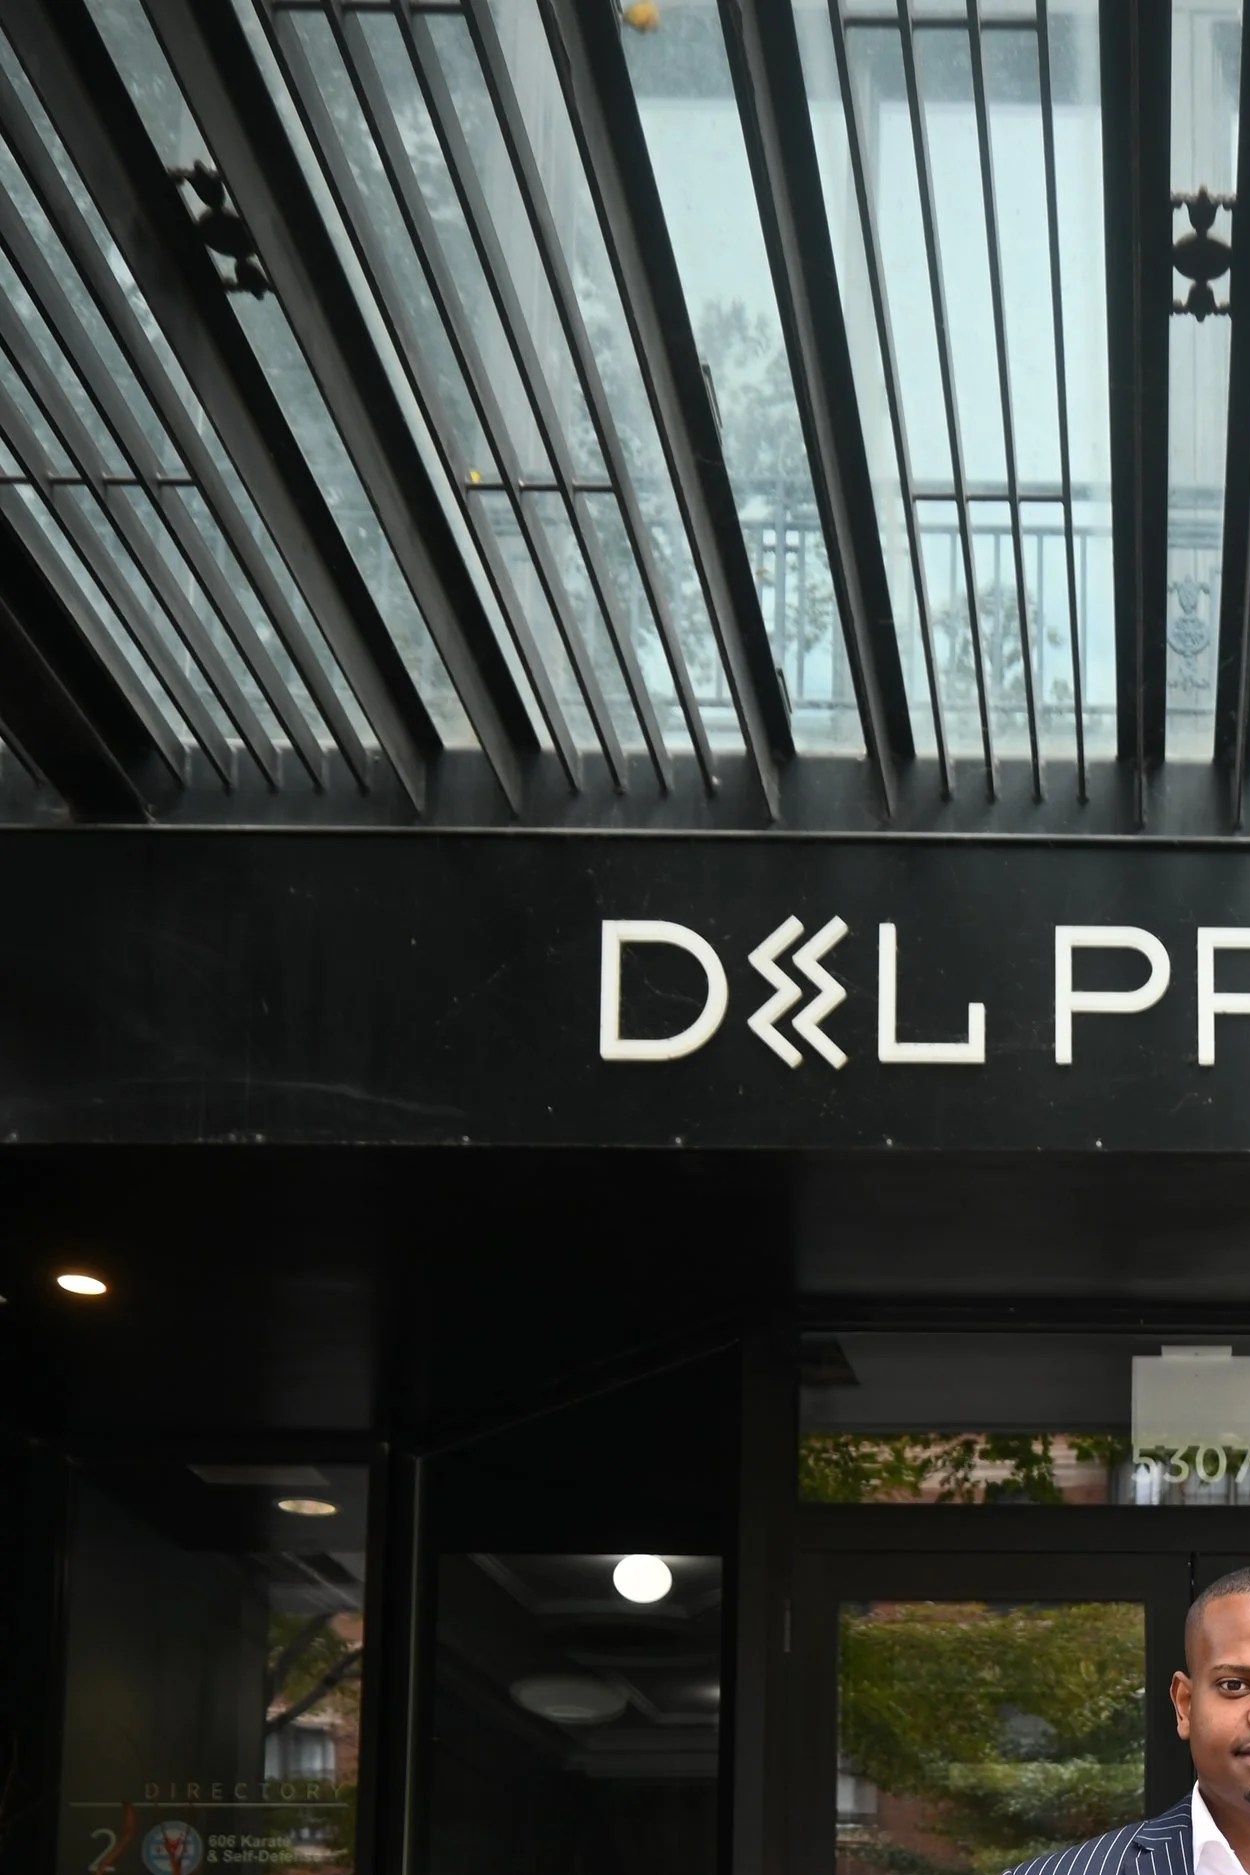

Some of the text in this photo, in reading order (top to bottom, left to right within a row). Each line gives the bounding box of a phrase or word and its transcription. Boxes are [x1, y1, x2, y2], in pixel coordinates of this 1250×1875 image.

[600, 914, 986, 1070] DEL
[144, 1782, 343, 1800] DIRECTORY
[87, 1828, 117, 1872] 2
[208, 1835, 292, 1848] 606 Karate
[206, 1849, 218, 1863] &
